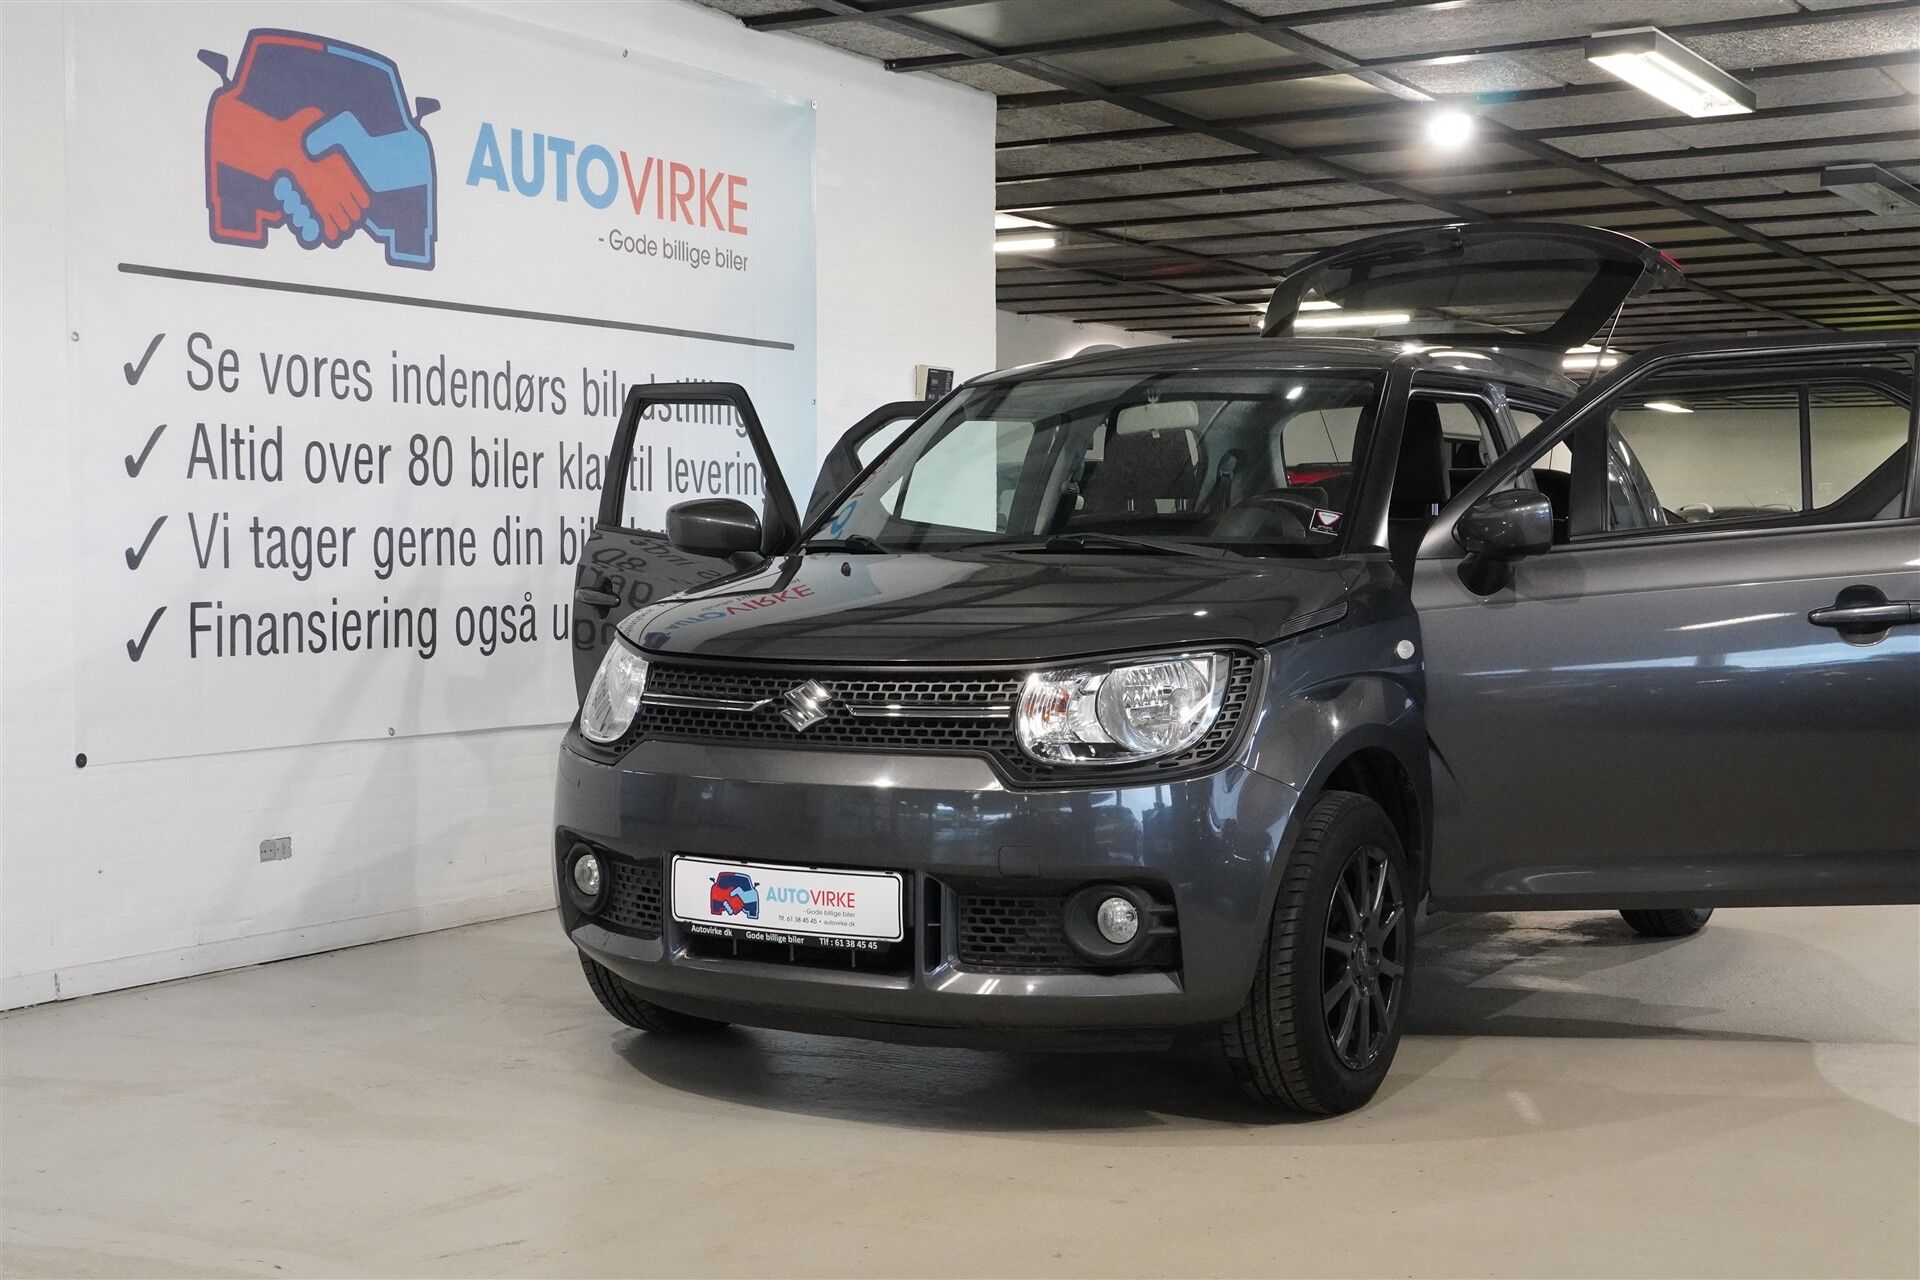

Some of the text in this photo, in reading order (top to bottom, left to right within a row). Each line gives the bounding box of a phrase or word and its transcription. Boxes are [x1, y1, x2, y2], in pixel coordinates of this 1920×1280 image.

[465, 121, 748, 236] AUTOVIRKE
[608, 228, 657, 257] Gode
[662, 238, 710, 269] billige
[715, 247, 749, 272] biler
[186, 332, 239, 393] Se
[260, 352, 373, 402] vores
[391, 350, 567, 415] indendørs
[186, 423, 283, 482] Altid
[304, 440, 392, 485] over
[408, 433, 453, 487] 80
[470, 436, 544, 489] biler
[630, 445, 652, 491] til
[187, 512, 230, 569] Vi
[249, 516, 356, 581] tager
[373, 526, 476, 580] gerne
[493, 515, 543, 566] din
[190, 596, 437, 659] Finansiering
[455, 592, 537, 656] også
[766, 886, 855, 908] AUTOVIRKE
[806, 908, 823, 916] Gode
[824, 909, 842, 918] billige
[690, 924, 723, 936] Autovirke
[745, 931, 764, 941] Gode
[765, 933, 787, 944] billige
[788, 935, 804, 944] biler
[819, 937, 829, 946] Tlf
[834, 939, 844, 947] 61
[845, 939, 855, 948] 38
[856, 941, 867, 949] 45
[867, 941, 878, 950] 45
